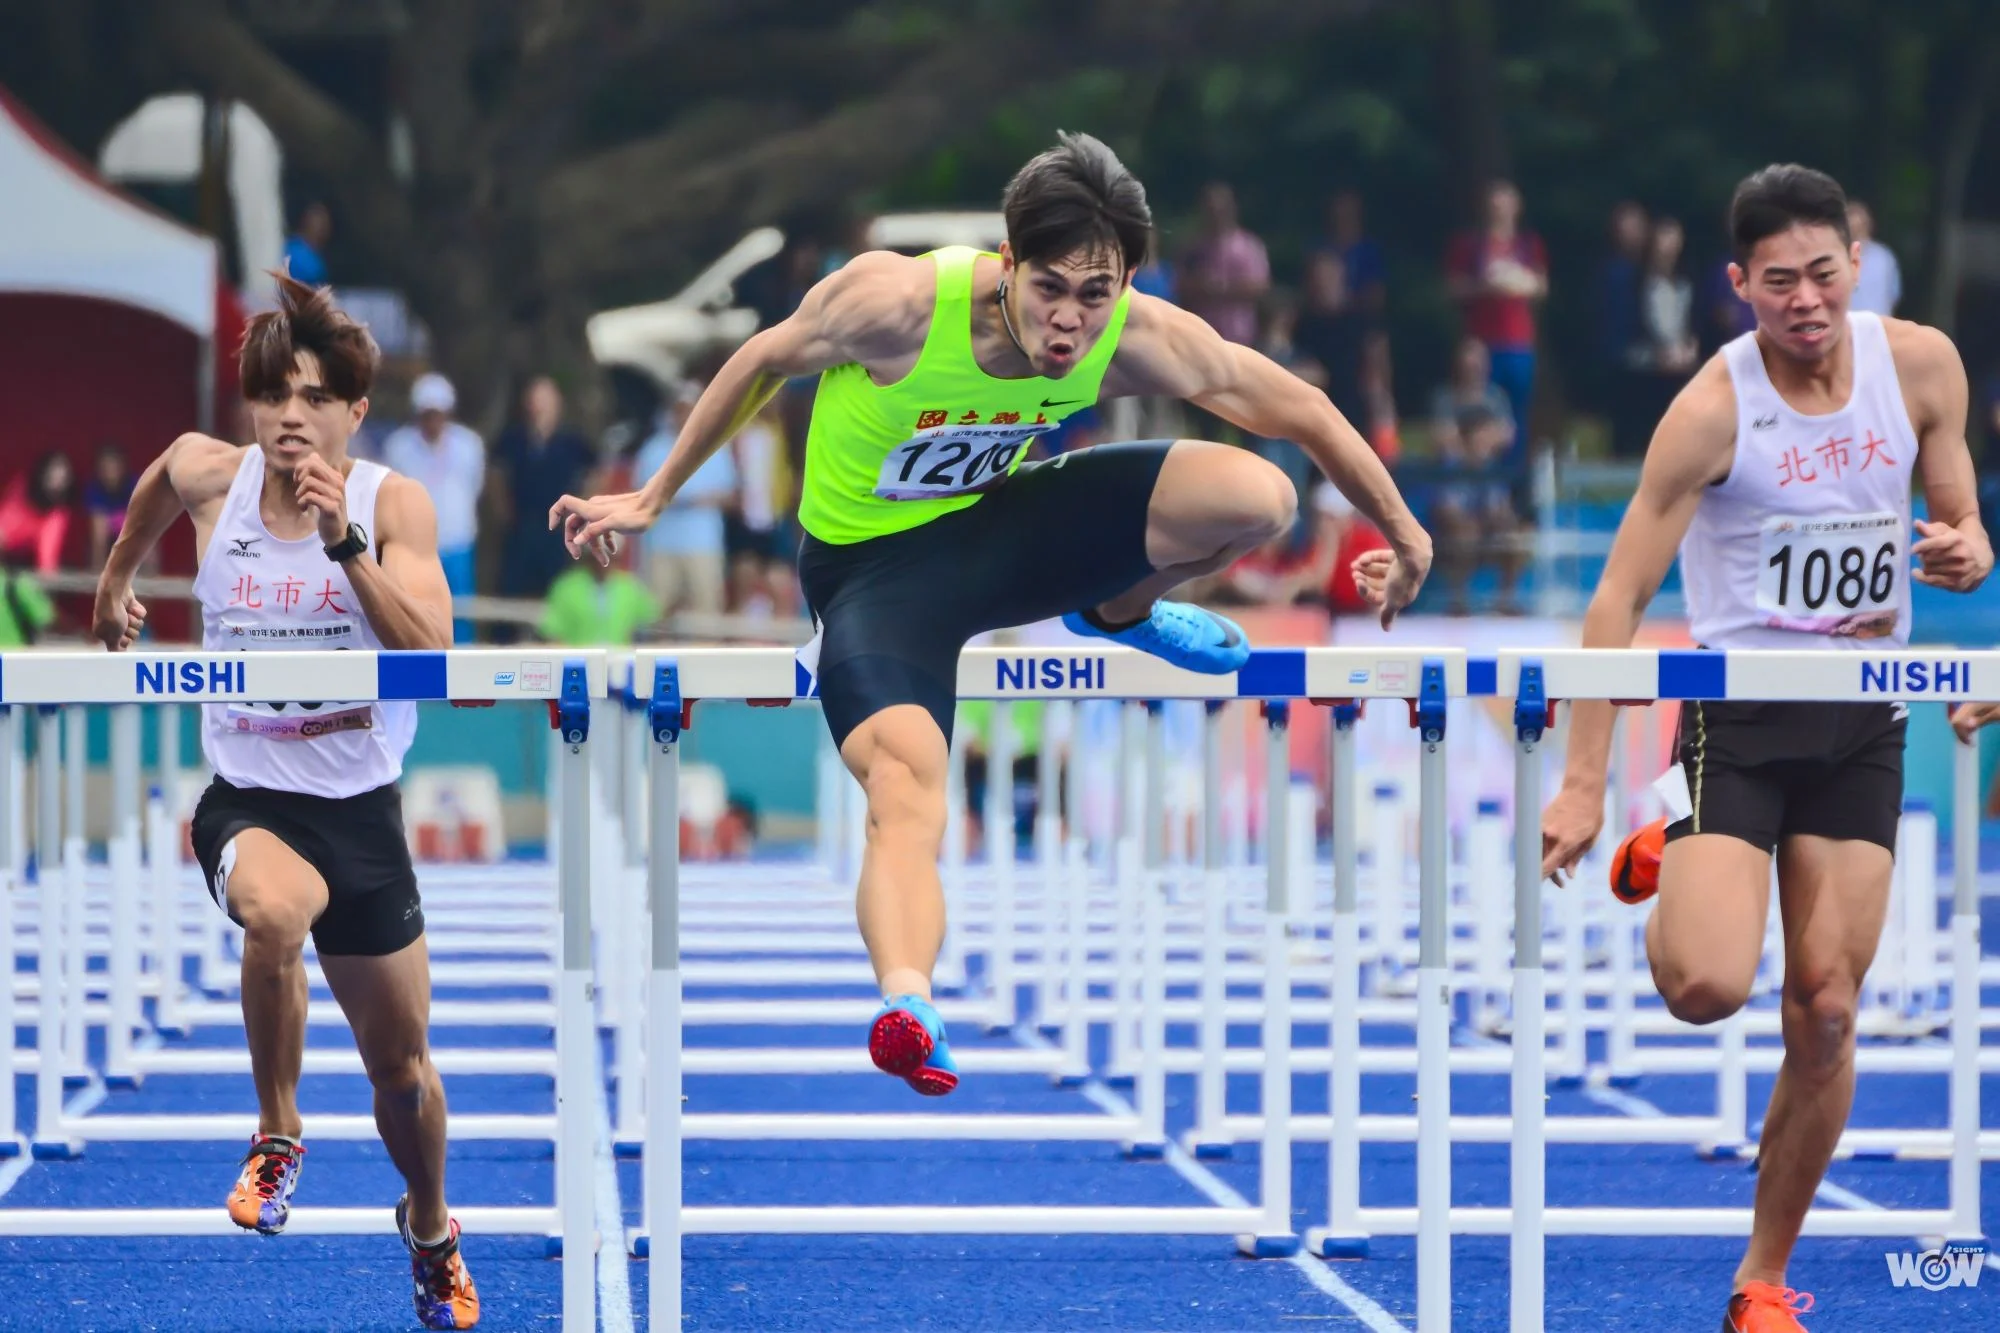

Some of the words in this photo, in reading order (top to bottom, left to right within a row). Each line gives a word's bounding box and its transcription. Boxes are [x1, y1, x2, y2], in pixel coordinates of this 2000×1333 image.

[1778, 429, 1898, 488] 北市大
[229, 574, 348, 615] 北市大
[1769, 542, 1896, 610] 1086
[135, 661, 246, 694] NISHI
[996, 658, 1105, 690] NISHI
[1860, 660, 1971, 692] NISHI
